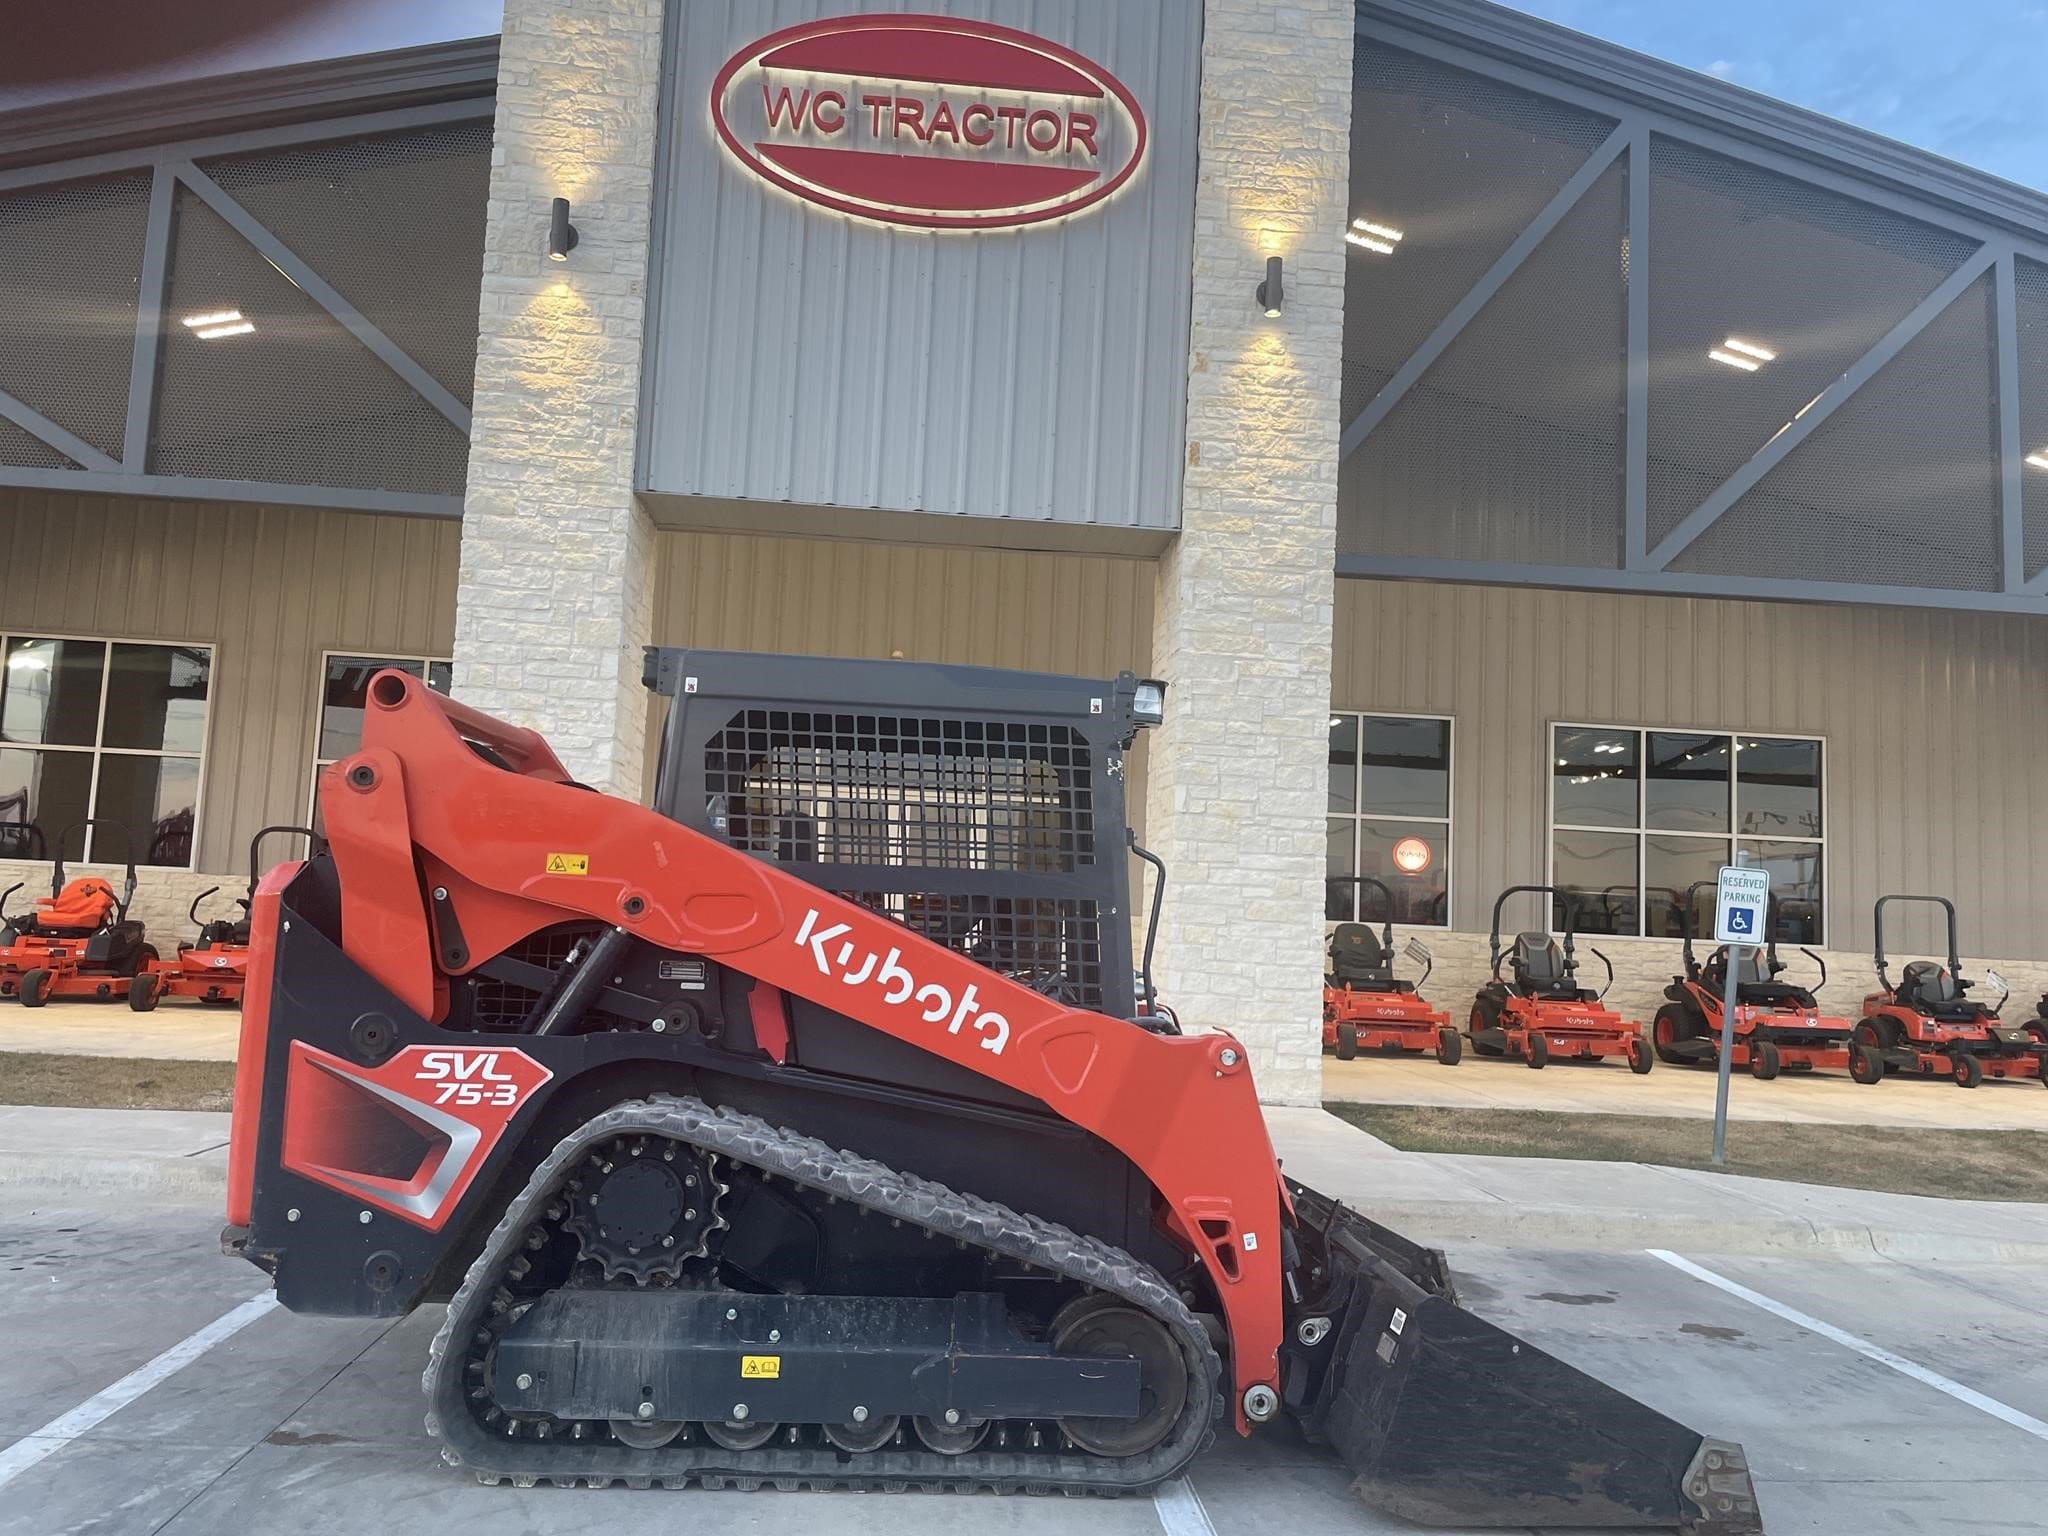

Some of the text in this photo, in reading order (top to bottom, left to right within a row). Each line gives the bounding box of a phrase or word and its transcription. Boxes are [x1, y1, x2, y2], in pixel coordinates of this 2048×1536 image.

[762, 84, 1099, 156] WC TRACTOR
[1722, 876, 1765, 889] RESERVED
[1723, 891, 1761, 904] PARKING
[794, 908, 1010, 1056] Kubota
[1376, 1007, 1405, 1016] Kubota
[1565, 1016, 1594, 1025] Kubota
[414, 1052, 513, 1081] SVL
[433, 1082, 518, 1106] 75-3
